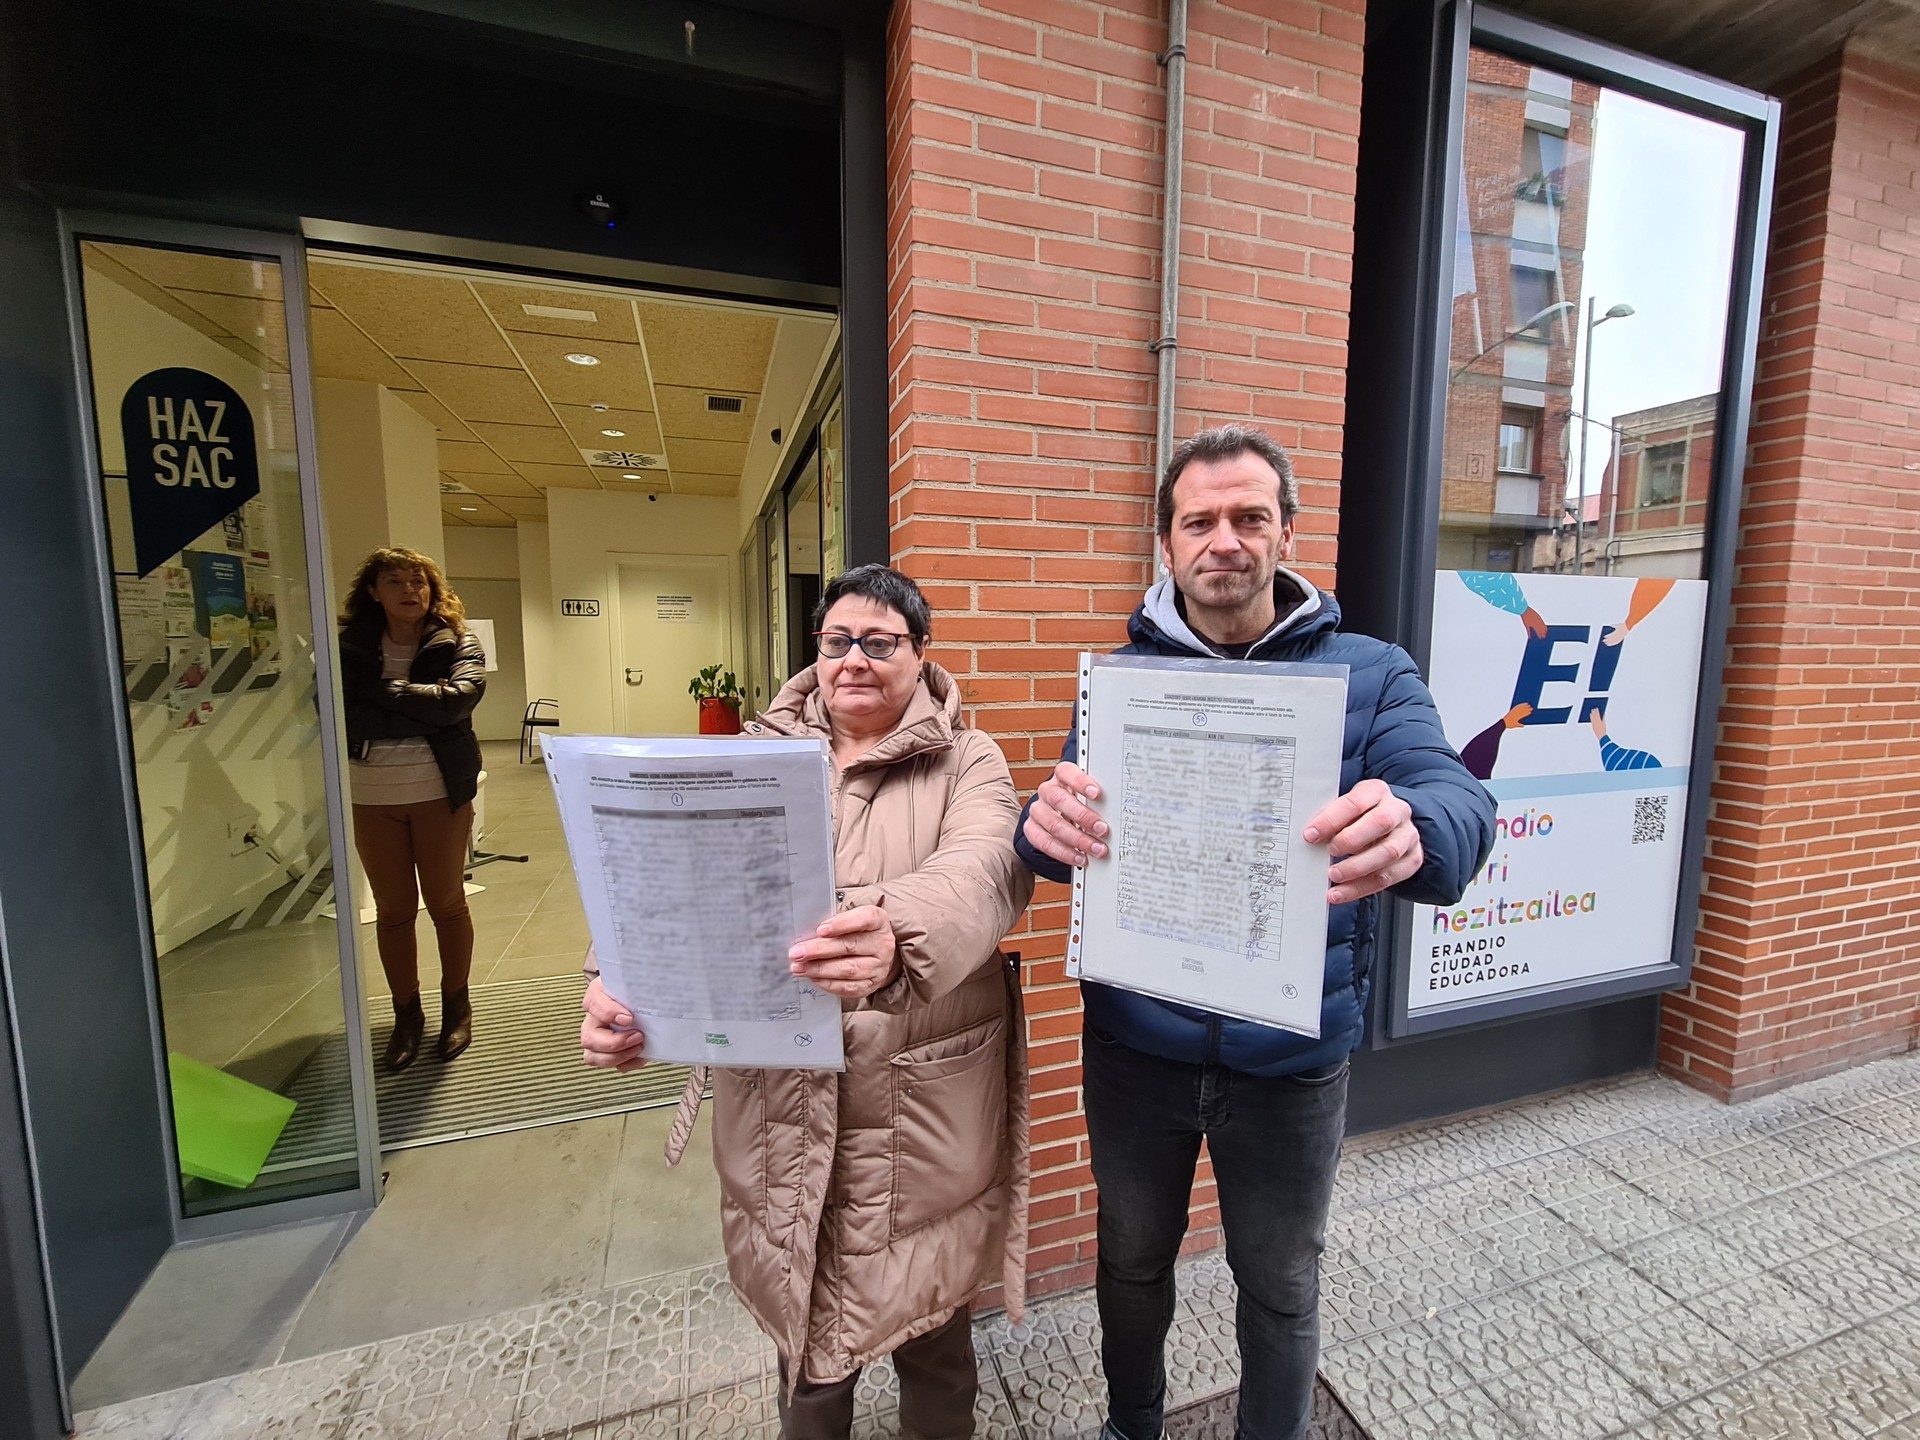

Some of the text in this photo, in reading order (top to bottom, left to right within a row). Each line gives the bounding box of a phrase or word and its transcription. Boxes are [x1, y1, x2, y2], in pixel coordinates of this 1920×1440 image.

[147, 396, 230, 443] HAZ
[152, 443, 236, 489] SAC
[1510, 624, 1624, 725] E!
[1496, 808, 1553, 839] ndio
[1433, 889, 1596, 935] hezitzailea
[1430, 953, 1493, 975] CIUDAD
[1432, 936, 1505, 958] ERANDIO
[1429, 962, 1530, 990] EDUCADORA
